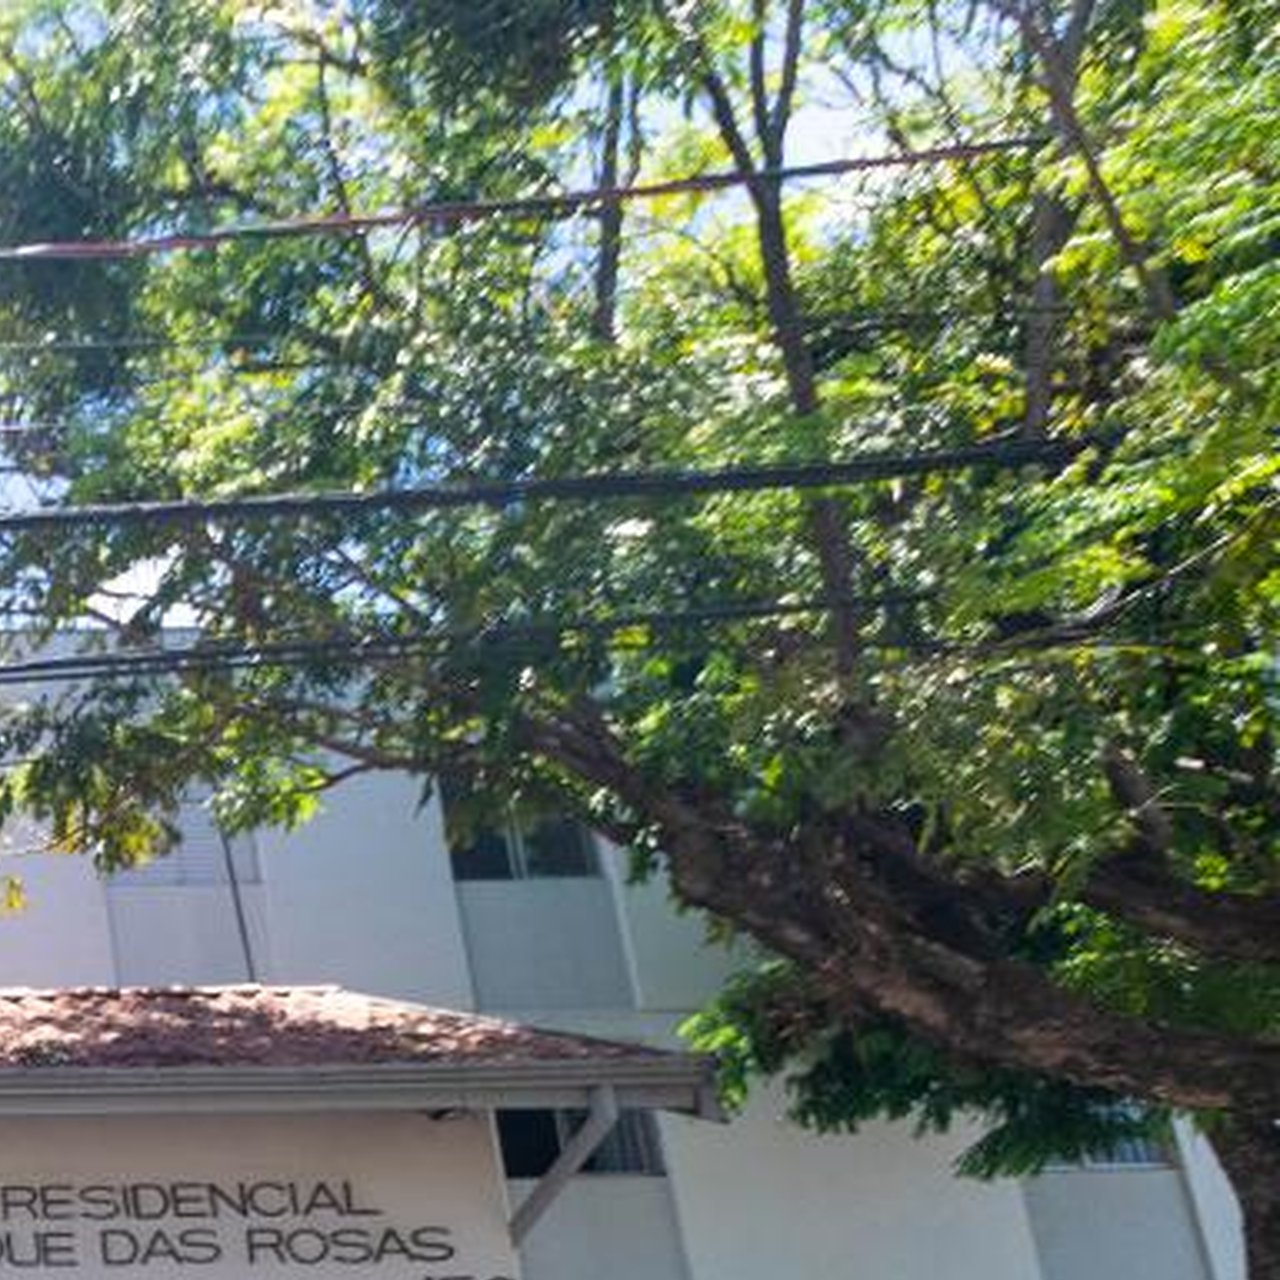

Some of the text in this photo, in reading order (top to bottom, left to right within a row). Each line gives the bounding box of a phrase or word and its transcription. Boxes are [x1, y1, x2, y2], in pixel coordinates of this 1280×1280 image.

[0, 1181, 381, 1221] RESIDENCIAL
[100, 1229, 221, 1266] DAS
[246, 1227, 455, 1265] ROSAS
